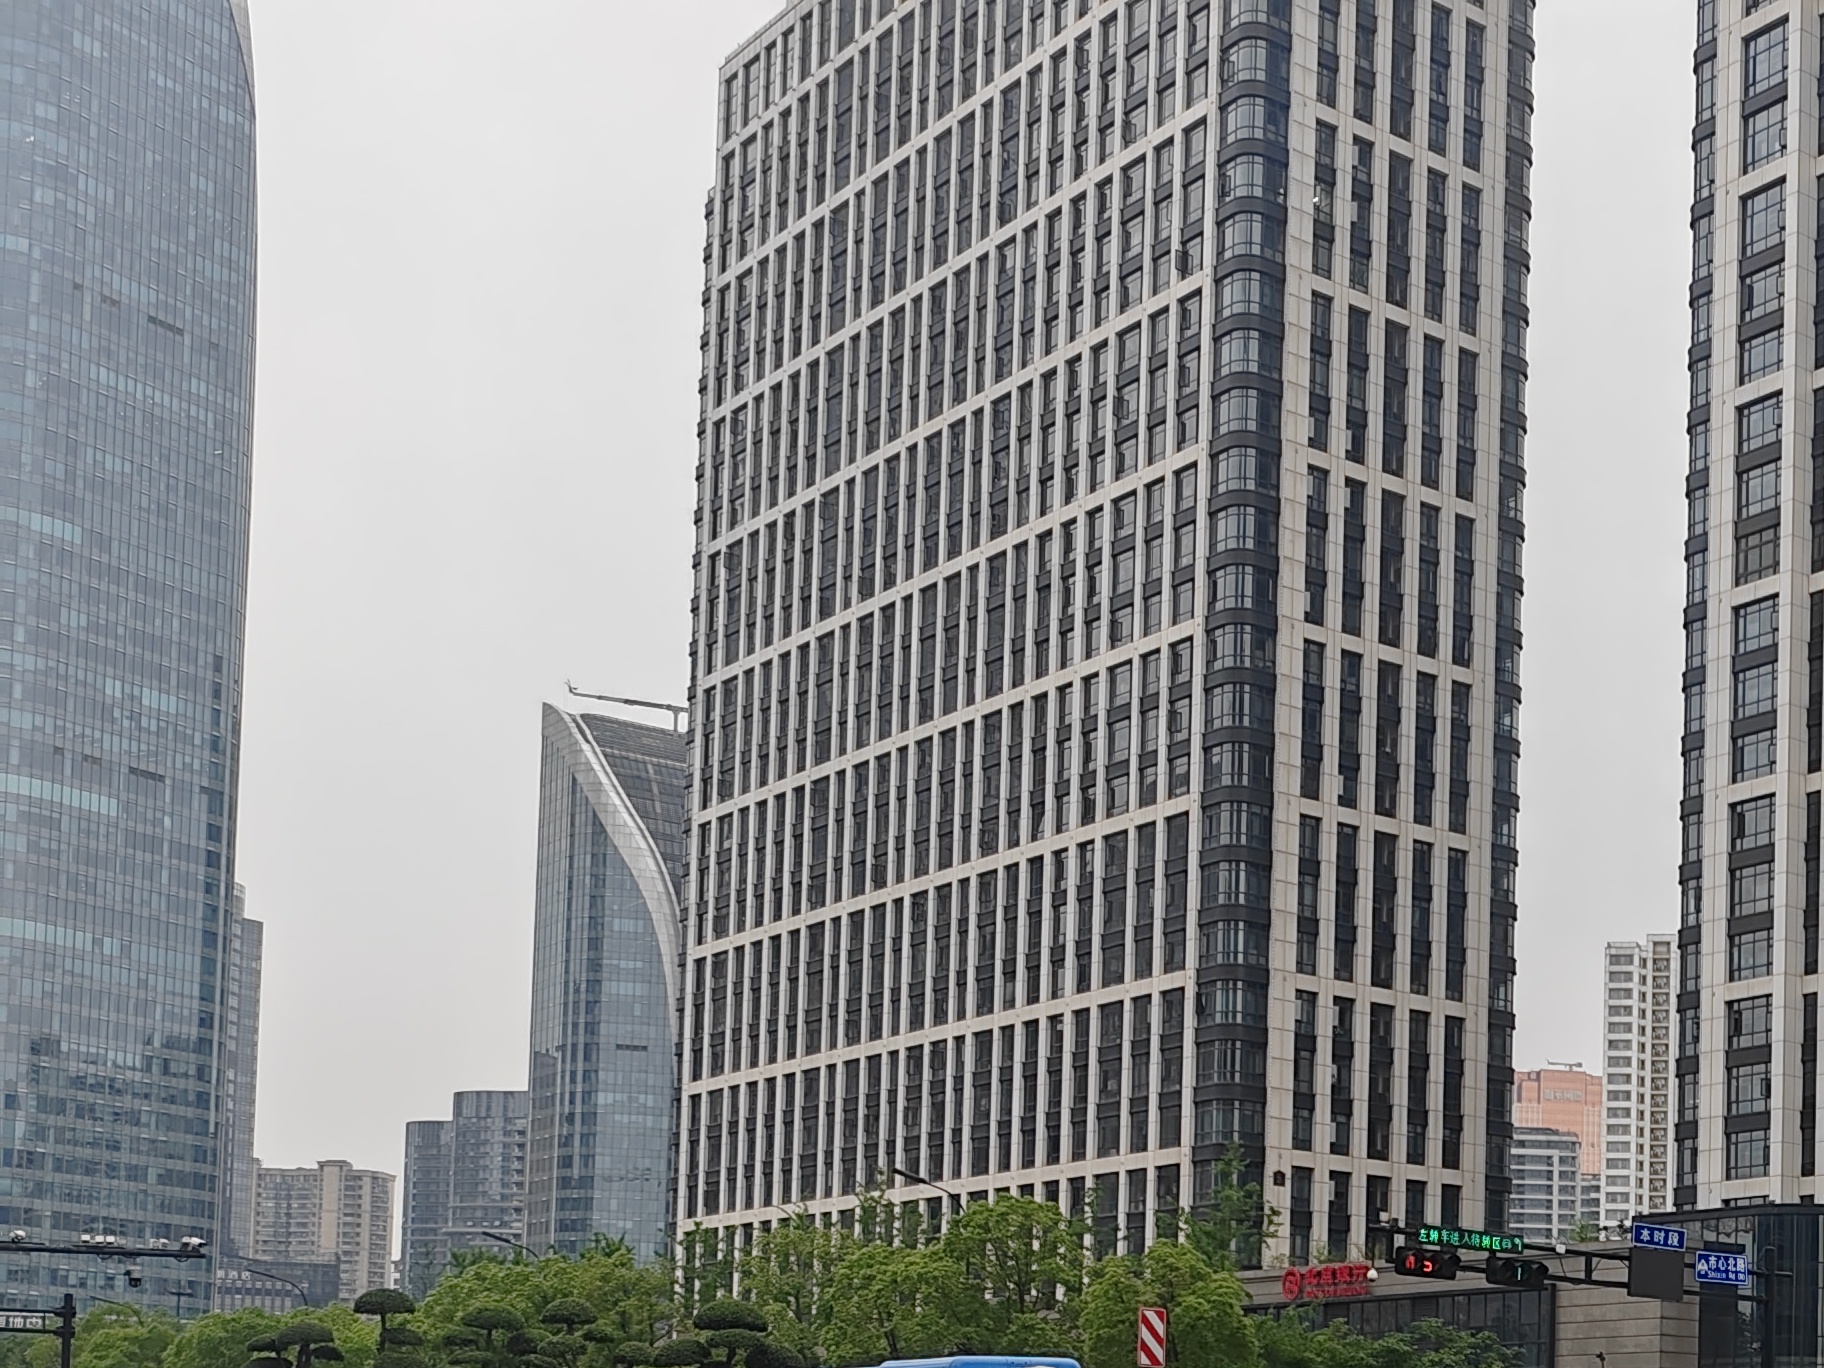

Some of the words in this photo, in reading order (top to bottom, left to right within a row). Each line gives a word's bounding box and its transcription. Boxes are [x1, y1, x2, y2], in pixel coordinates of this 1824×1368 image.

[1640, 1227, 1680, 1247] 本时段
[1708, 1255, 1746, 1273] 市心北路
